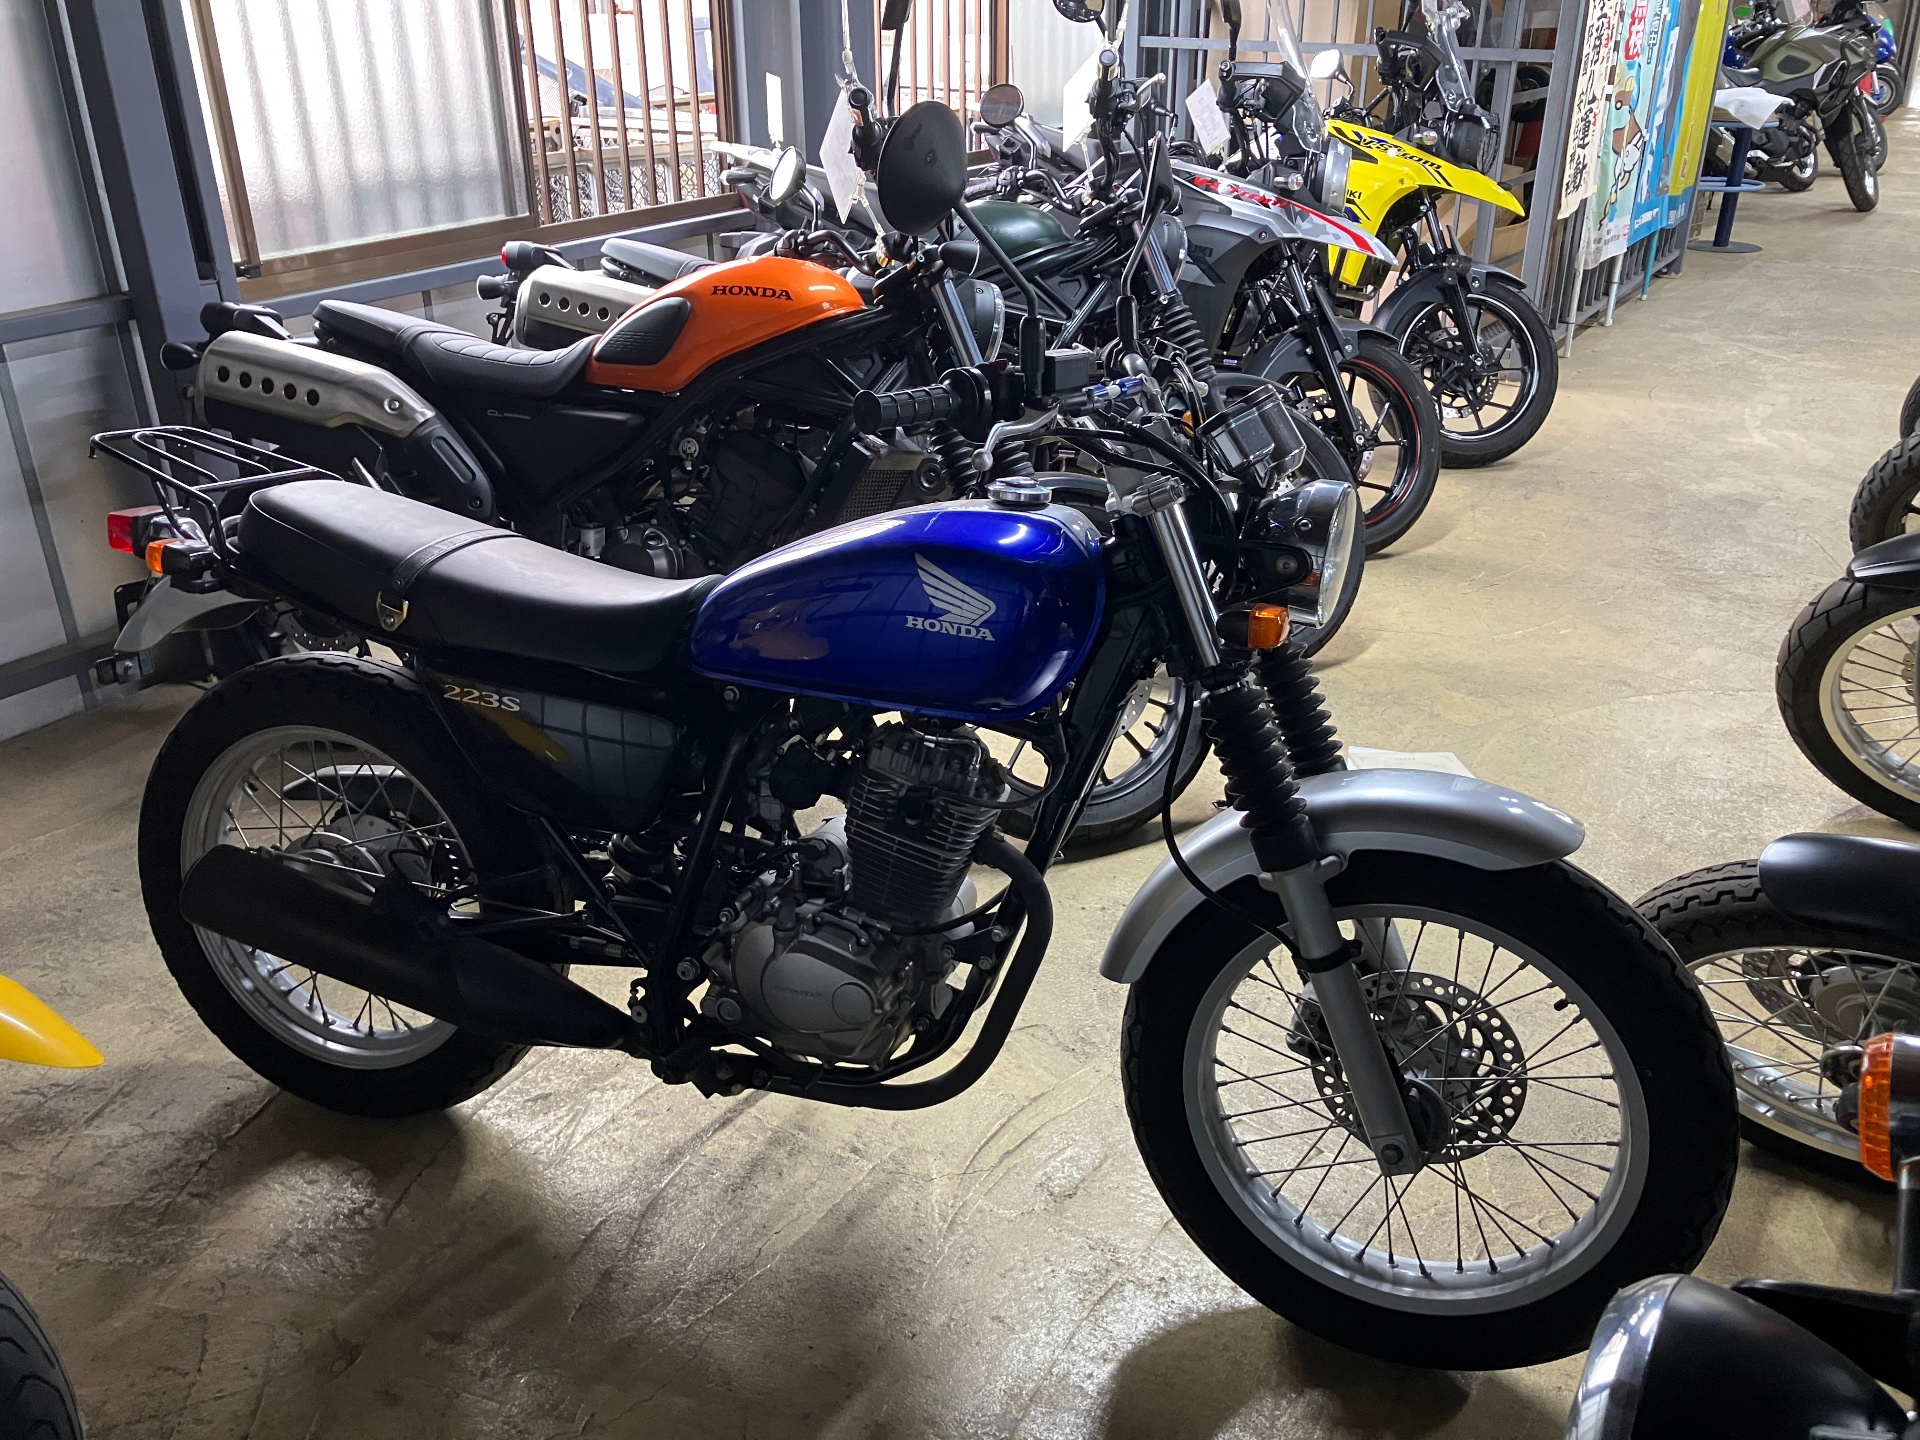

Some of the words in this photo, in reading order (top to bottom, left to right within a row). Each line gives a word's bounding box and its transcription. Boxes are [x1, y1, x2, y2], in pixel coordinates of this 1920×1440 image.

[711, 285, 794, 301] HONDA
[905, 615, 996, 641] HONDA
[443, 684, 520, 712] 223S
